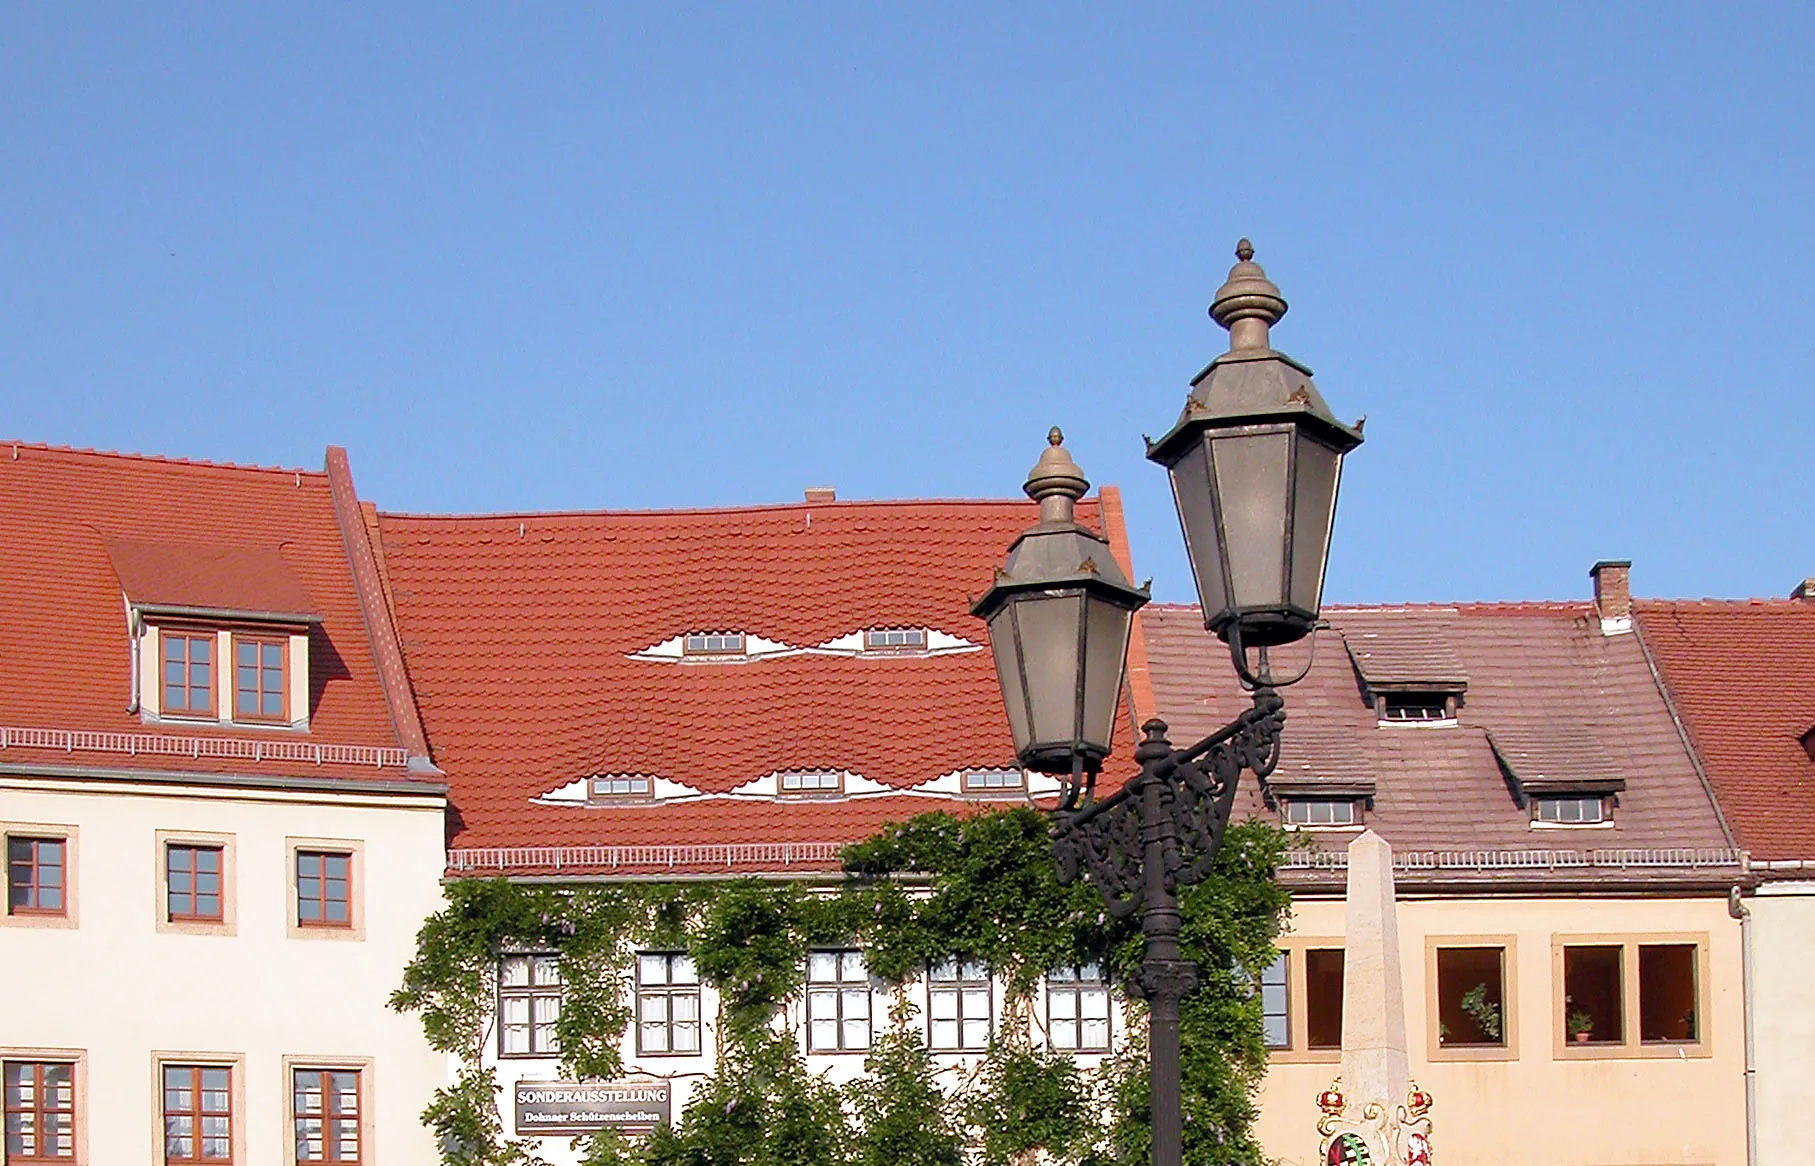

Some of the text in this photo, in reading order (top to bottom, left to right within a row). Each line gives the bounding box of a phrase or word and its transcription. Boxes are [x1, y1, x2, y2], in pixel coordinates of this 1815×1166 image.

[517, 1089, 667, 1104] SONDERAUSSTELLUNG
[525, 1111, 660, 1123] Dohnaer Schützenscheiben
